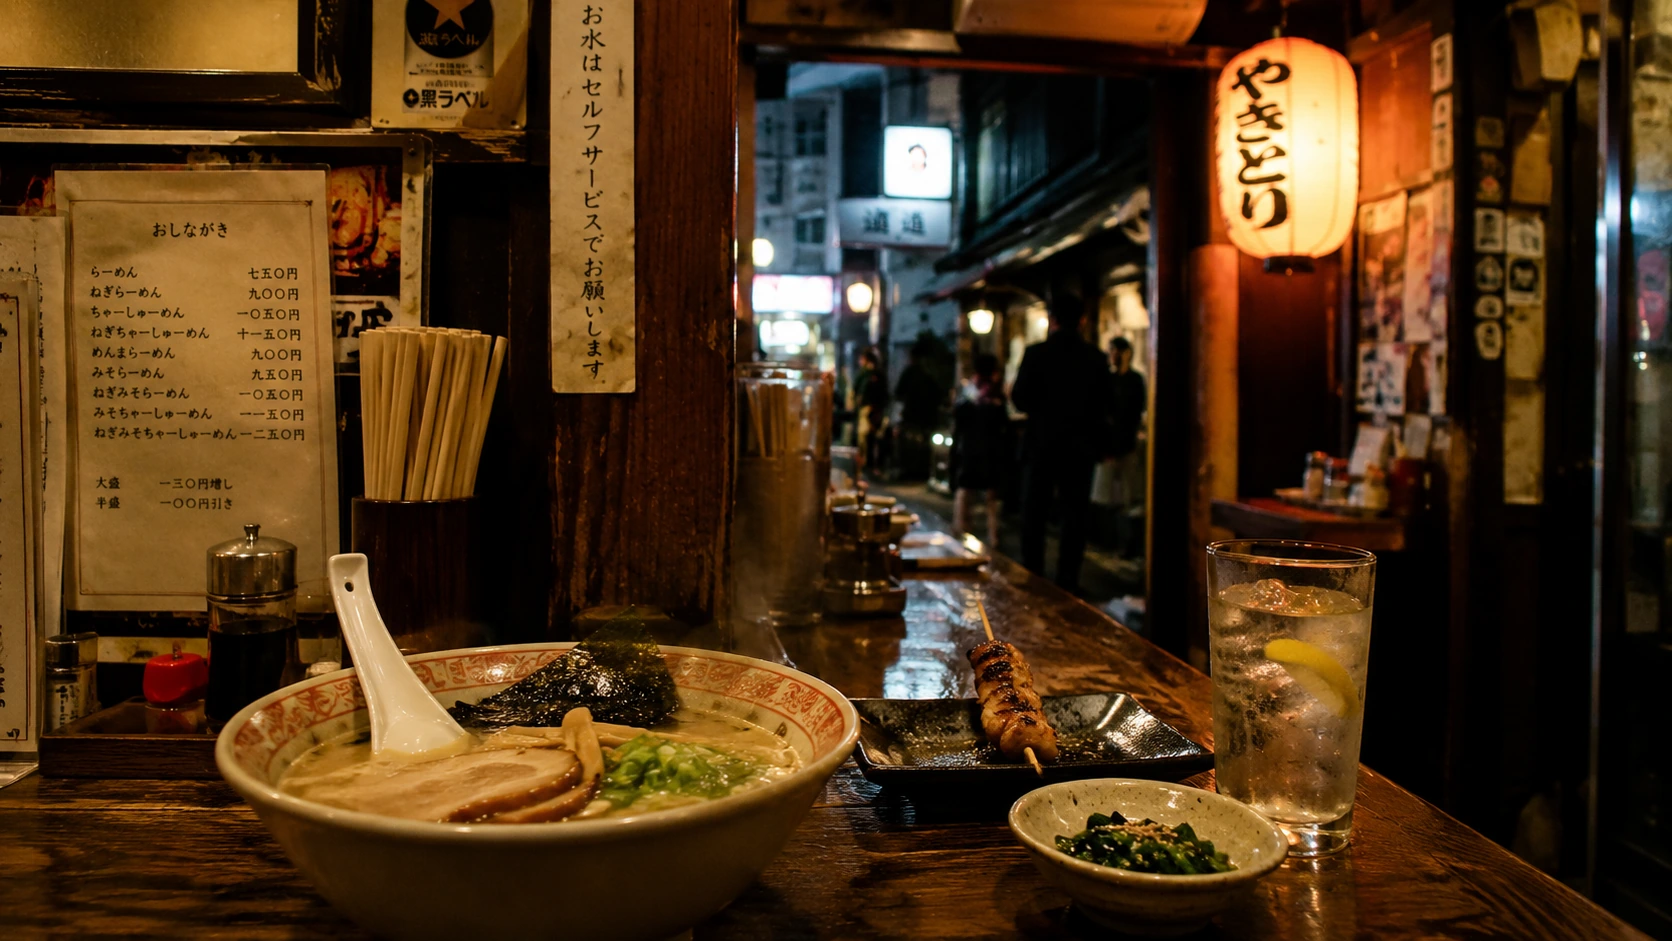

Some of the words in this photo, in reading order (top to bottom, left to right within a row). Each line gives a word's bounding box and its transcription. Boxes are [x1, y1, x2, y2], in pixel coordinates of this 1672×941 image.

[1232, 58, 1292, 230] やきとり
[580, 4, 607, 380] お水はセルフサービスでお願いします
[152, 221, 229, 239] おしながき
[90, 265, 139, 279] らーめん
[247, 266, 299, 281] 七五〇円
[89, 285, 162, 299] ねぎらーめん
[248, 286, 300, 301] 九〇〇円
[90, 305, 186, 319] ちゃーしゅーめん
[90, 325, 211, 340] ねぎちゃーしゅーめん
[91, 346, 177, 360] めんまらーめん
[251, 348, 303, 362] 九〇〇円
[91, 365, 166, 380] みそらーめん
[251, 368, 303, 382] 九五〇円
[92, 385, 191, 400] ねぎみそらーめん
[93, 406, 214, 421] みそちゃーしゅーめん
[93, 426, 237, 441] ねぎみそちゃーしゅーめん
[95, 476, 122, 491] 大盛
[159, 477, 234, 491] 一三〇円増し
[95, 495, 122, 510] 半盛
[159, 497, 234, 511] 一〇〇円引き
